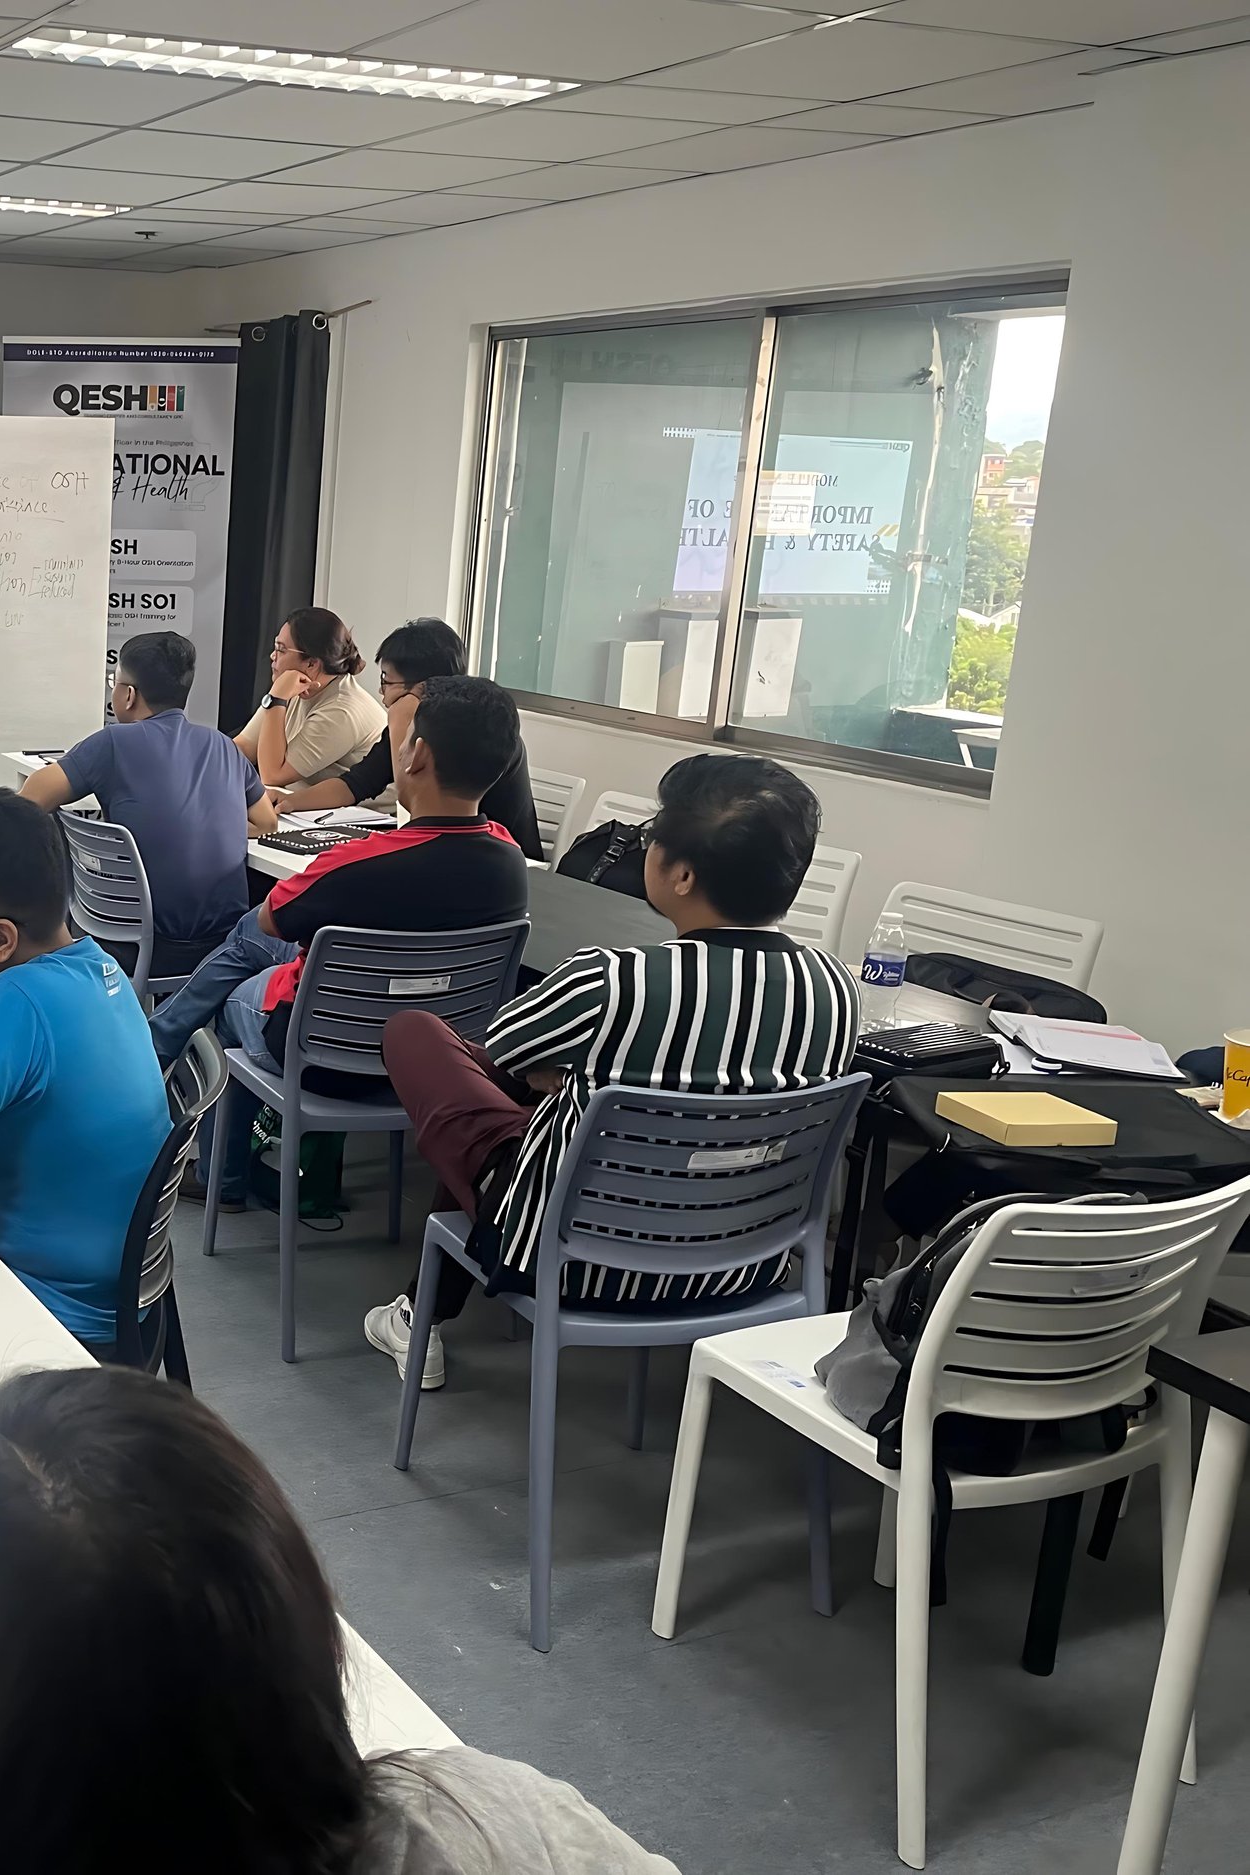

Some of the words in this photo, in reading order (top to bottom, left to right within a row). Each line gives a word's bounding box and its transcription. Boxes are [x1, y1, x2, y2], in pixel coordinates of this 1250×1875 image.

[52, 383, 148, 416] QESH
[113, 453, 225, 476] ATIONAL
[51, 471, 90, 495] OSH
[131, 470, 188, 503] Health
[110, 538, 138, 554] SH
[108, 592, 135, 609] SH
[140, 593, 176, 610] SO1
